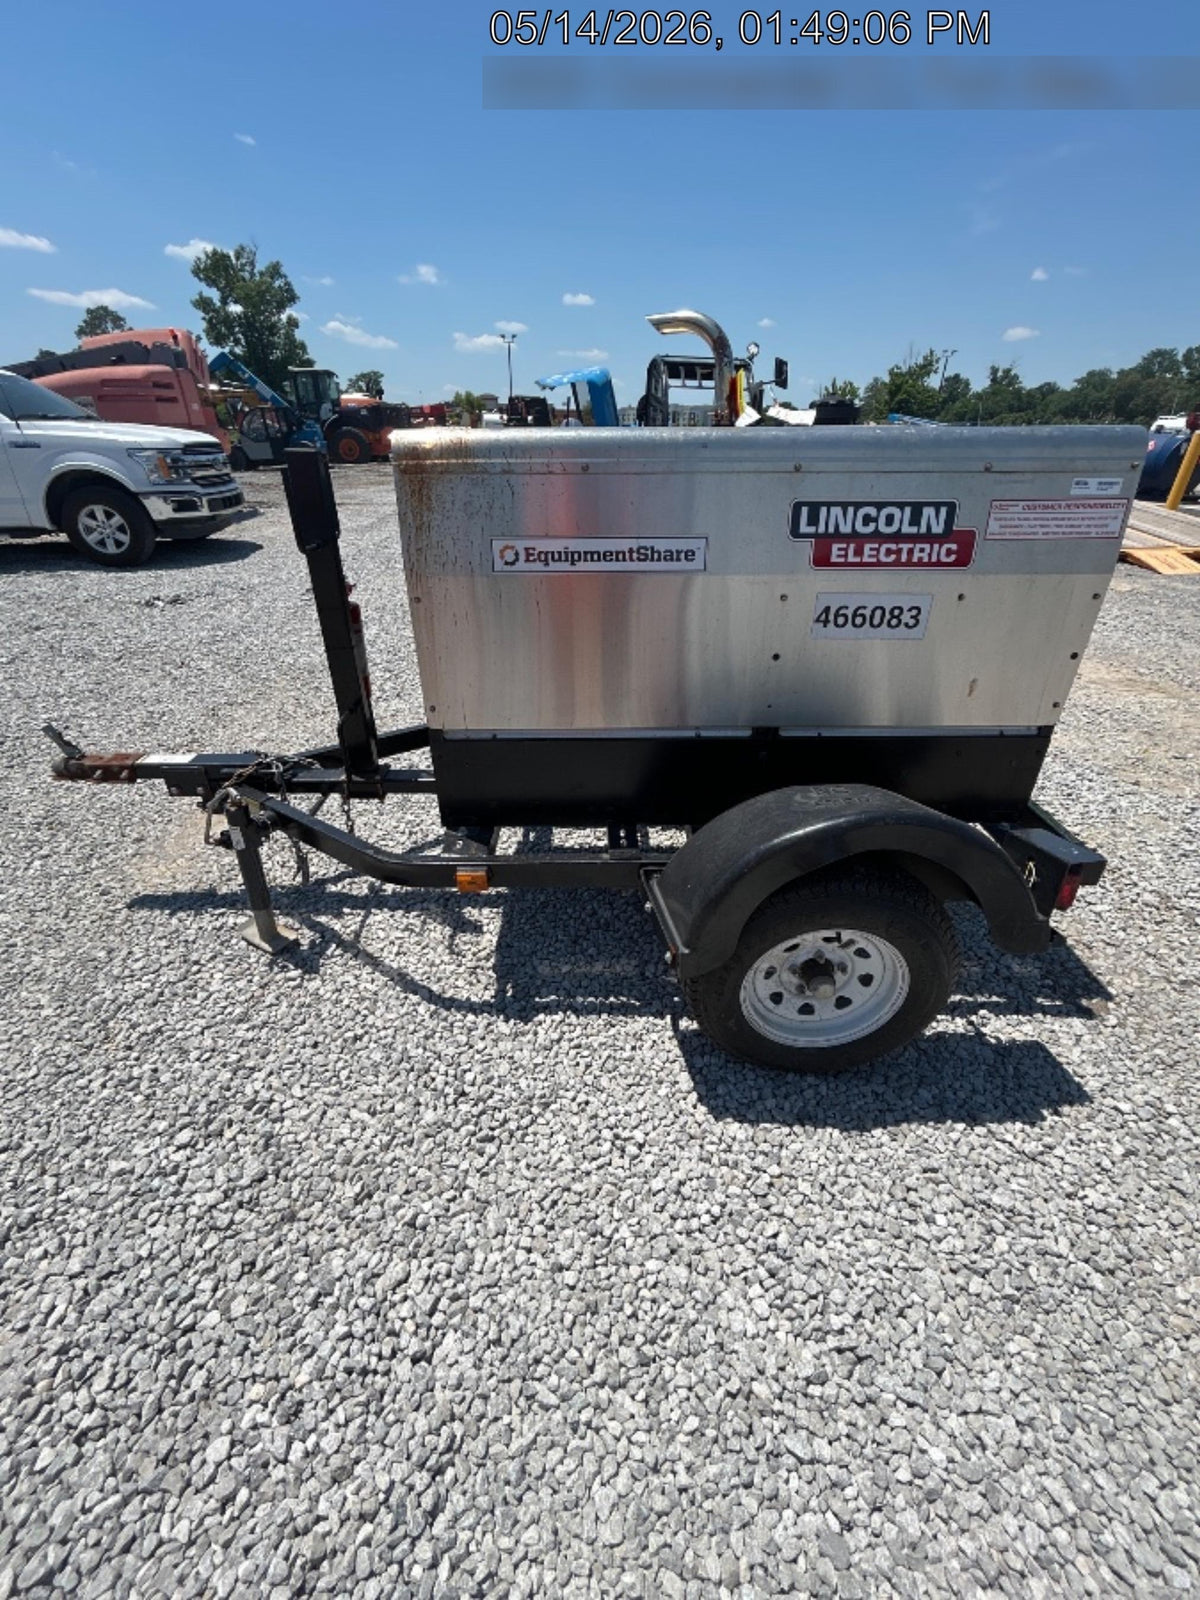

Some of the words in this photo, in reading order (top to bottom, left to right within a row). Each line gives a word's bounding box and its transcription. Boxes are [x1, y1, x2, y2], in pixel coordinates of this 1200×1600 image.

[799, 505, 948, 534] LINCOLN
[523, 545, 697, 566] EquipmentShare
[829, 543, 958, 563] ELECTRIC
[813, 605, 922, 629] 466083
